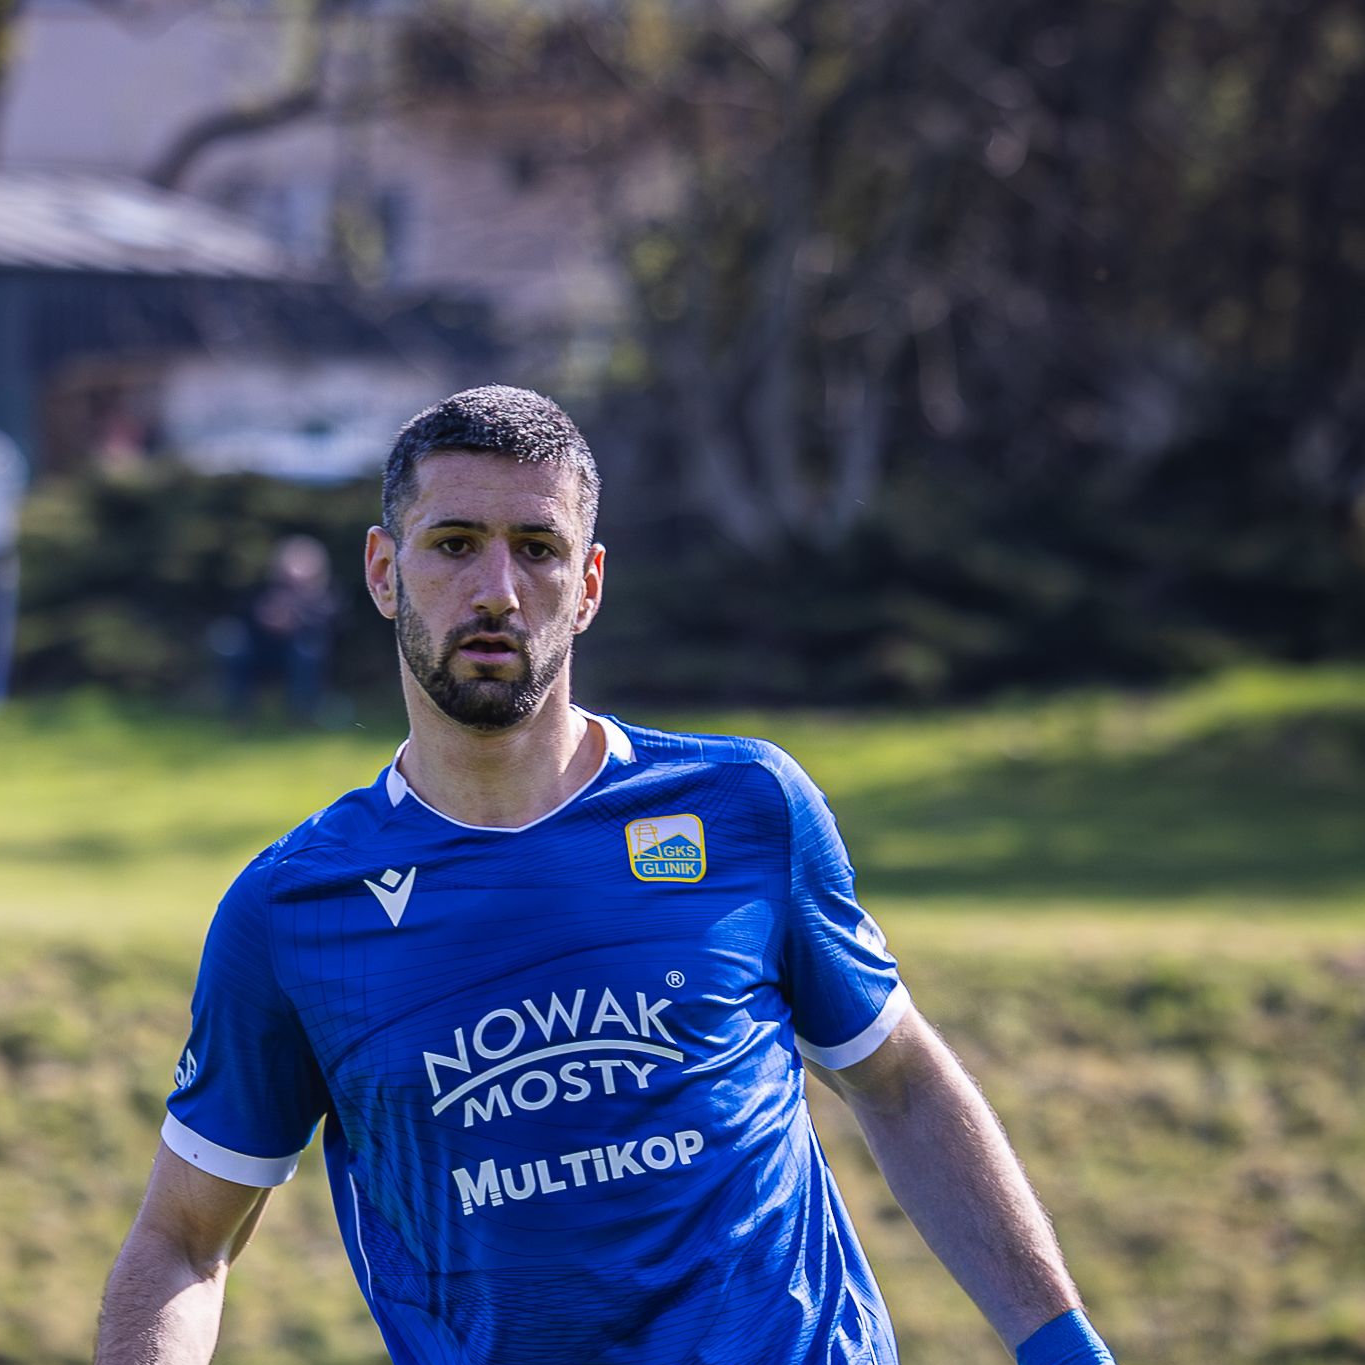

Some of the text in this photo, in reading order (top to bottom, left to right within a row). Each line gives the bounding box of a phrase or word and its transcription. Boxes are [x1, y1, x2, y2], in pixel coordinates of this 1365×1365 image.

[642, 862, 696, 876] GLINIK
[663, 845, 696, 857] GKS
[423, 986, 678, 1097] NOWAK
[464, 1059, 658, 1128] MOSTY
